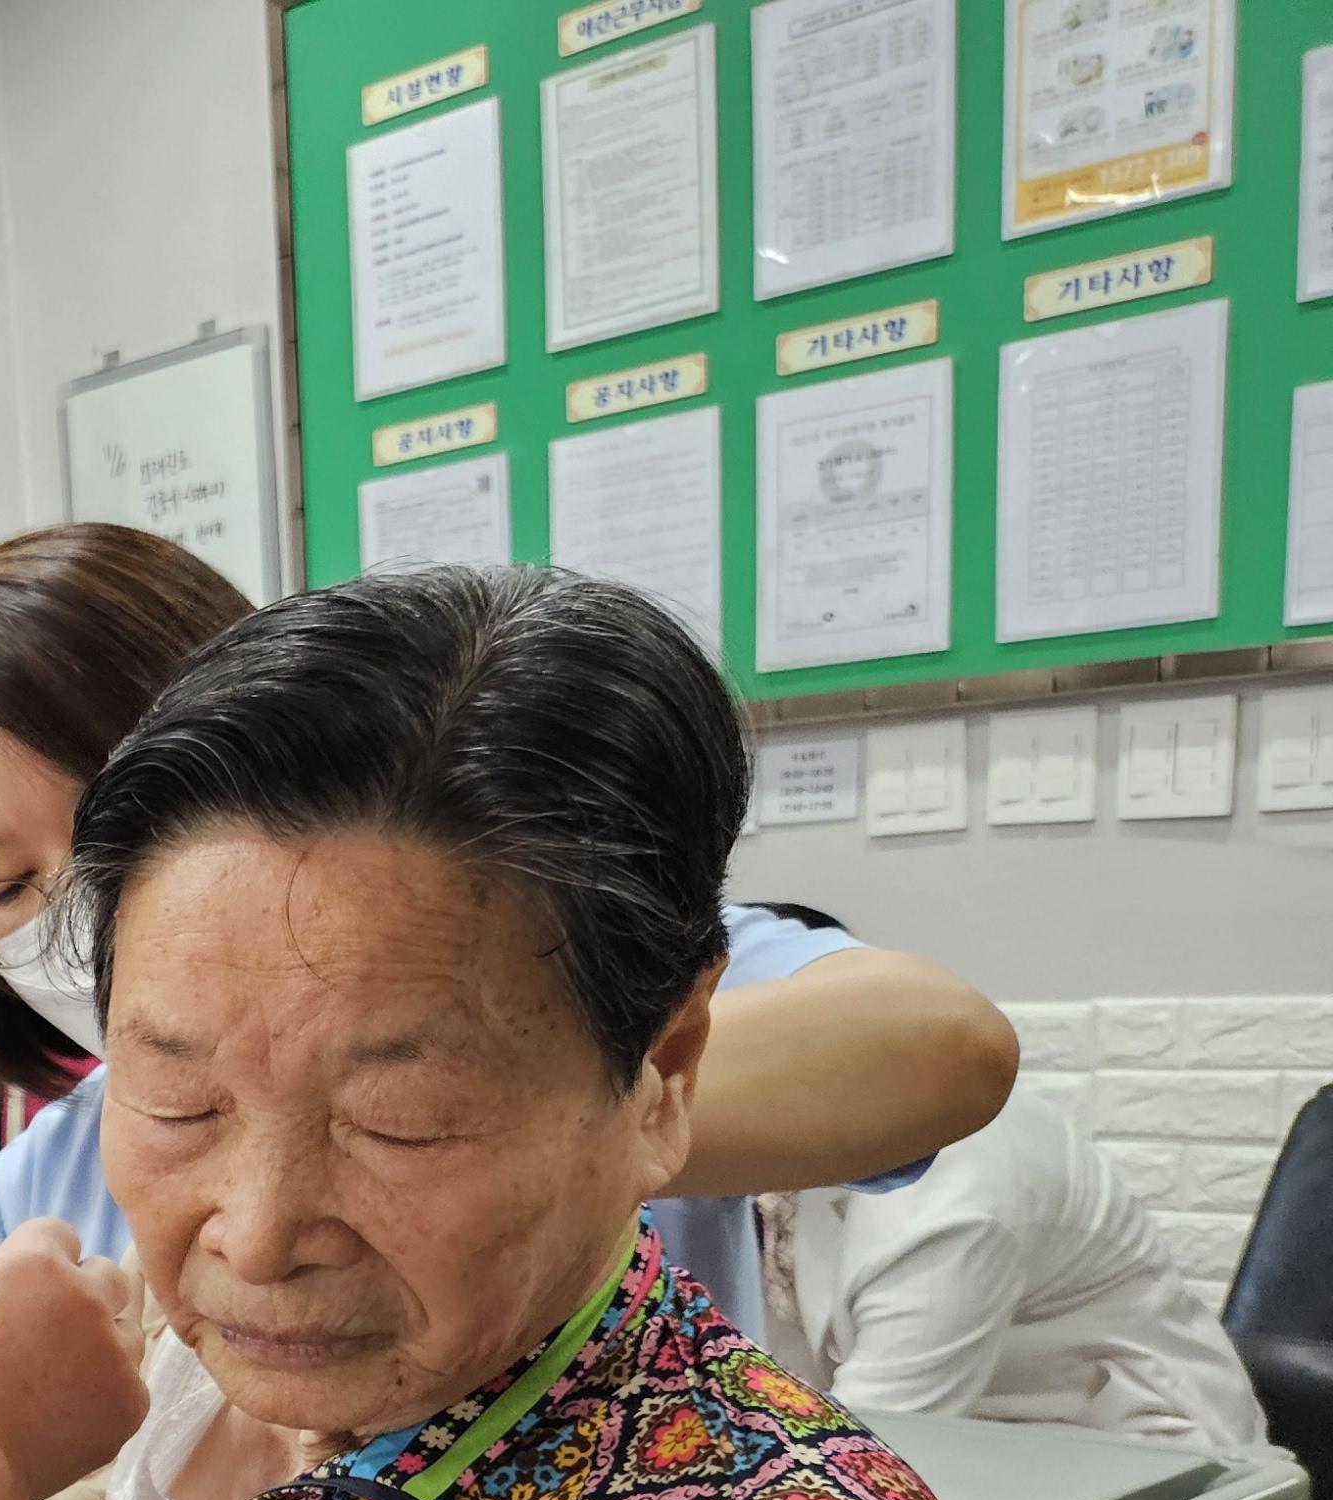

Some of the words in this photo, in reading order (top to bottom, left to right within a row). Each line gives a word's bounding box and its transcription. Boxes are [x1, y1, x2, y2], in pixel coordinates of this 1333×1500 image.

[385, 63, 465, 107] 시설현황
[1057, 254, 1176, 303] 기타사항
[806, 317, 909, 359] 기타사항
[591, 367, 682, 408] 공지사항
[395, 415, 476, 454] 공지사항
